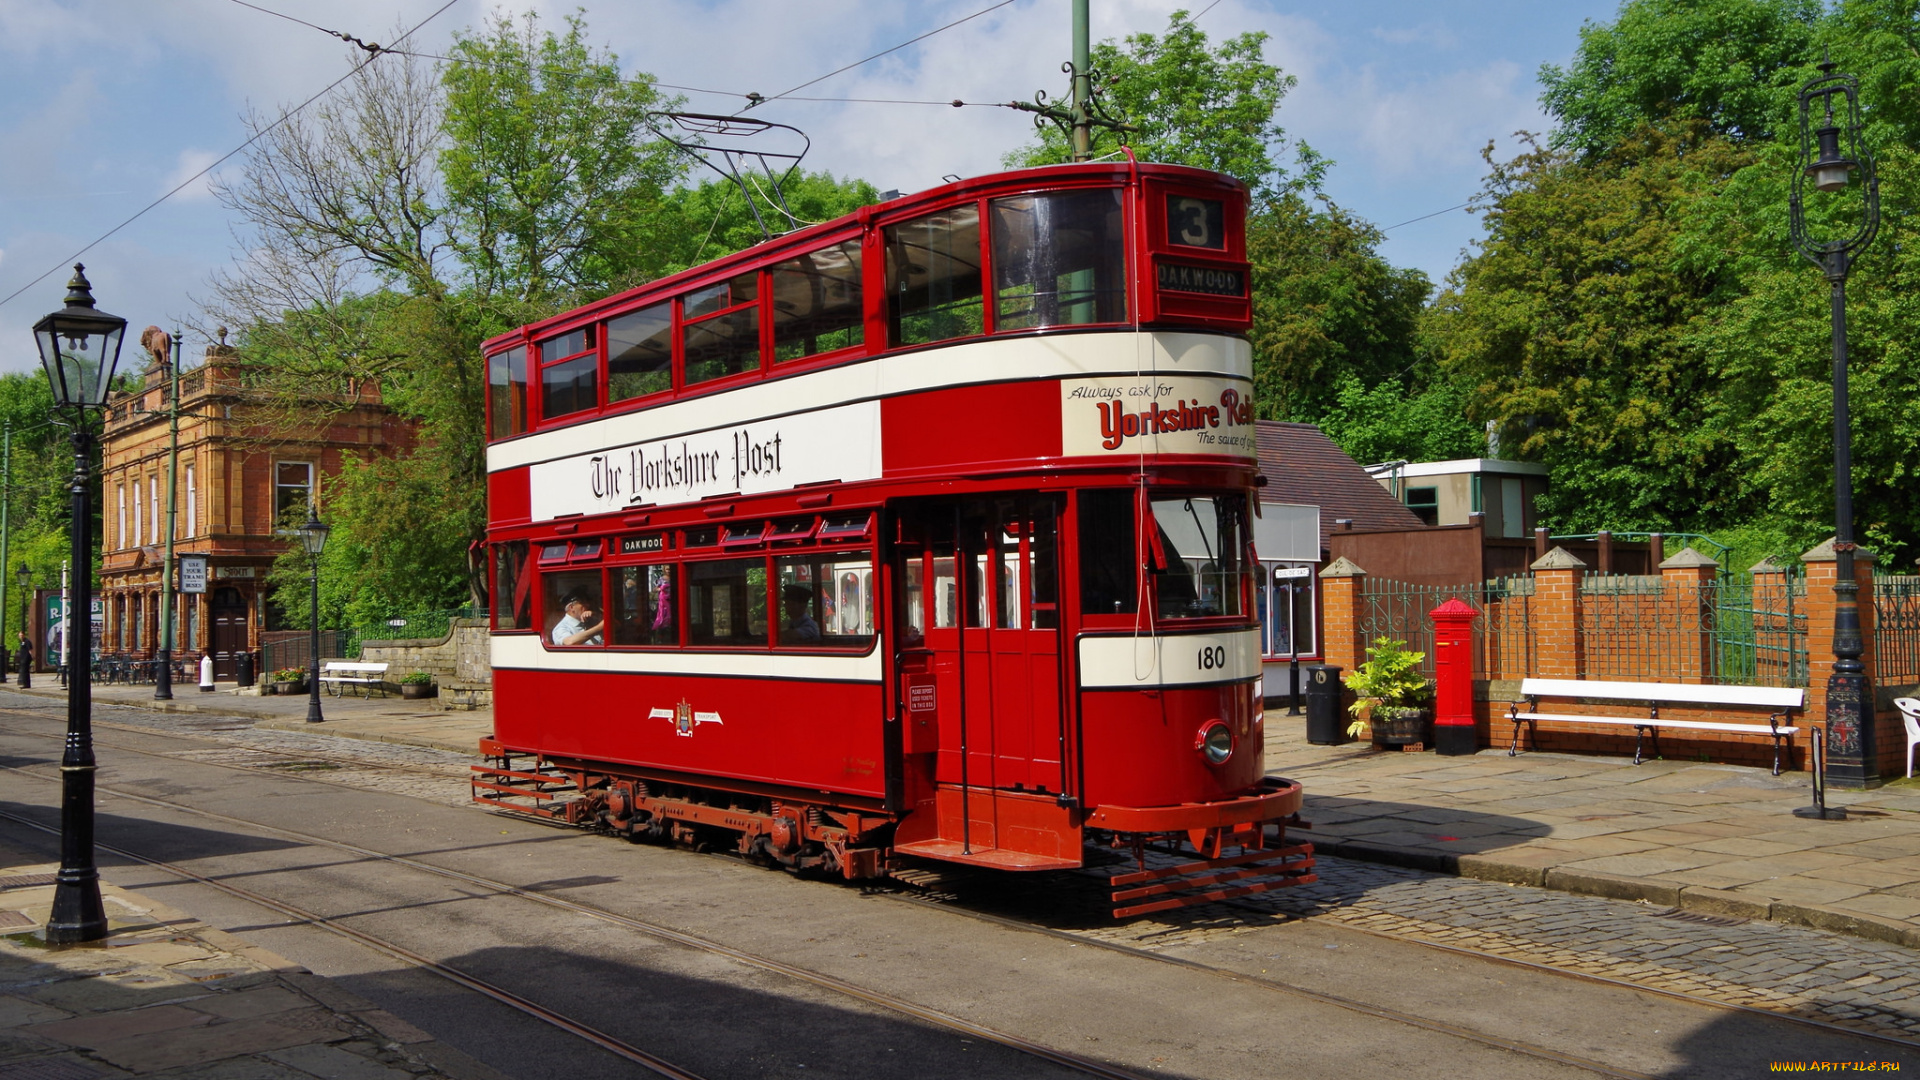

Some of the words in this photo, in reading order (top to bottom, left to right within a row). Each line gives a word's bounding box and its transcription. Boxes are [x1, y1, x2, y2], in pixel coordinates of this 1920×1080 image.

[1179, 198, 1208, 246] 3
[1158, 264, 1237, 290] OAKWOOD
[1067, 386, 1123, 400] Always
[1128, 384, 1151, 397] ask
[1154, 383, 1174, 399] for
[1096, 398, 1220, 450] Yorkshire
[1197, 431, 1216, 444] The
[1218, 435, 1239, 446] sauce
[1240, 434, 1247, 449] of
[590, 454, 622, 505] The
[629, 440, 719, 504] Yorkshire
[731, 429, 782, 490] Post
[1198, 645, 1225, 670] 180
